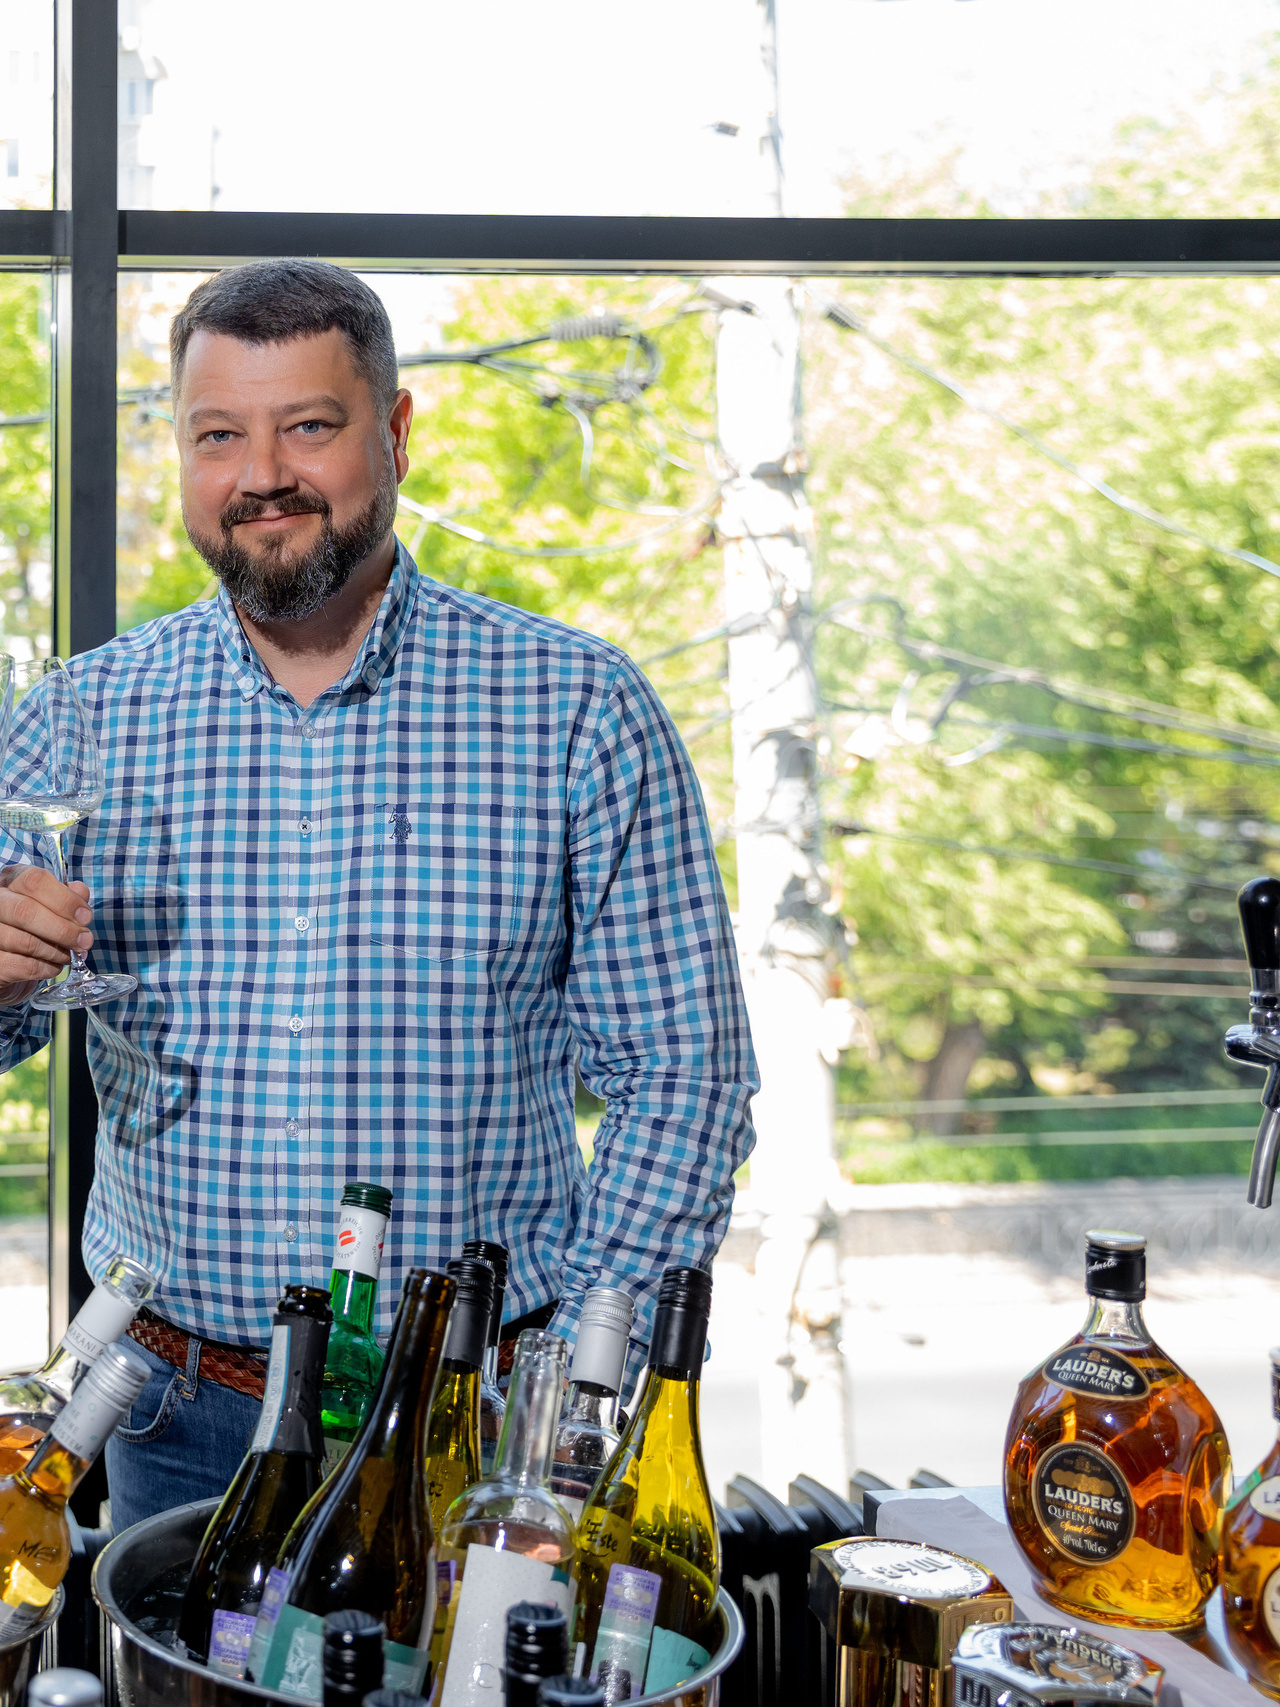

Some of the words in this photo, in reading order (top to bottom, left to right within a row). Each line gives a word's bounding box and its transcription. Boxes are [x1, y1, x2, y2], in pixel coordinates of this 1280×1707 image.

[1052, 1358, 1135, 1389] LAUDER'S
[1057, 1370, 1087, 1383] QUEEN
[1088, 1378, 1118, 1393] MARY
[1044, 1483, 1124, 1515] LAUDER'S
[1047, 1505, 1085, 1522] QUEEN
[1088, 1515, 1120, 1531] MARY
